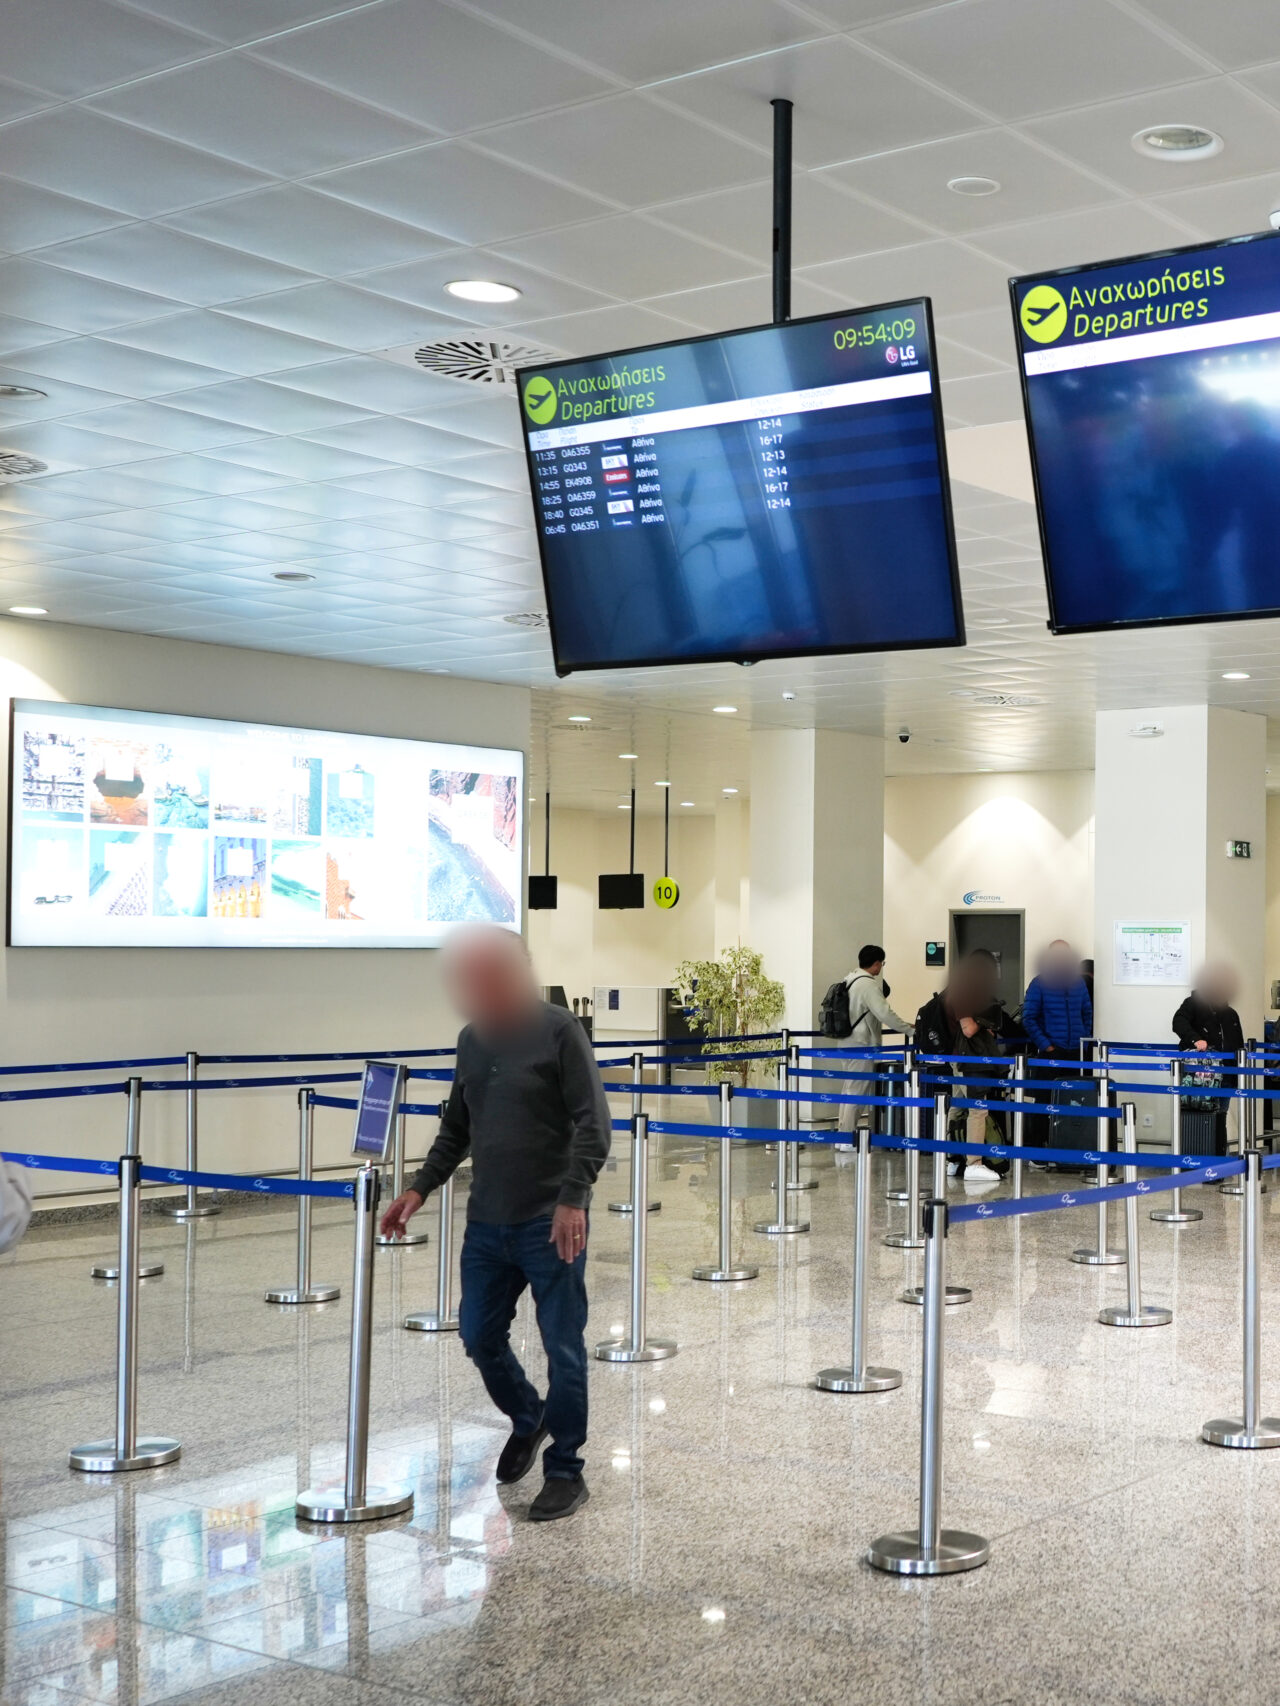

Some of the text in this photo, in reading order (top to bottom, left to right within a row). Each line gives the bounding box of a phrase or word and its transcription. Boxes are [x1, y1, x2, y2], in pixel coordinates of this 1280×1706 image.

[1069, 266, 1225, 310] Αναχωρήσεις
[1073, 298, 1208, 338] Departures
[833, 318, 916, 350] 09:54:09
[899, 345, 916, 361] LG
[558, 365, 666, 398] Αναχωρήσεις
[561, 391, 656, 422] Departures
[758, 418, 782, 430] 12-14
[760, 434, 783, 446] 16-17
[761, 450, 785, 462] 12-13
[763, 466, 787, 478] 12-14
[765, 482, 788, 493] 16-17
[767, 498, 791, 509] 12-14
[658, 886, 673, 899] 10
